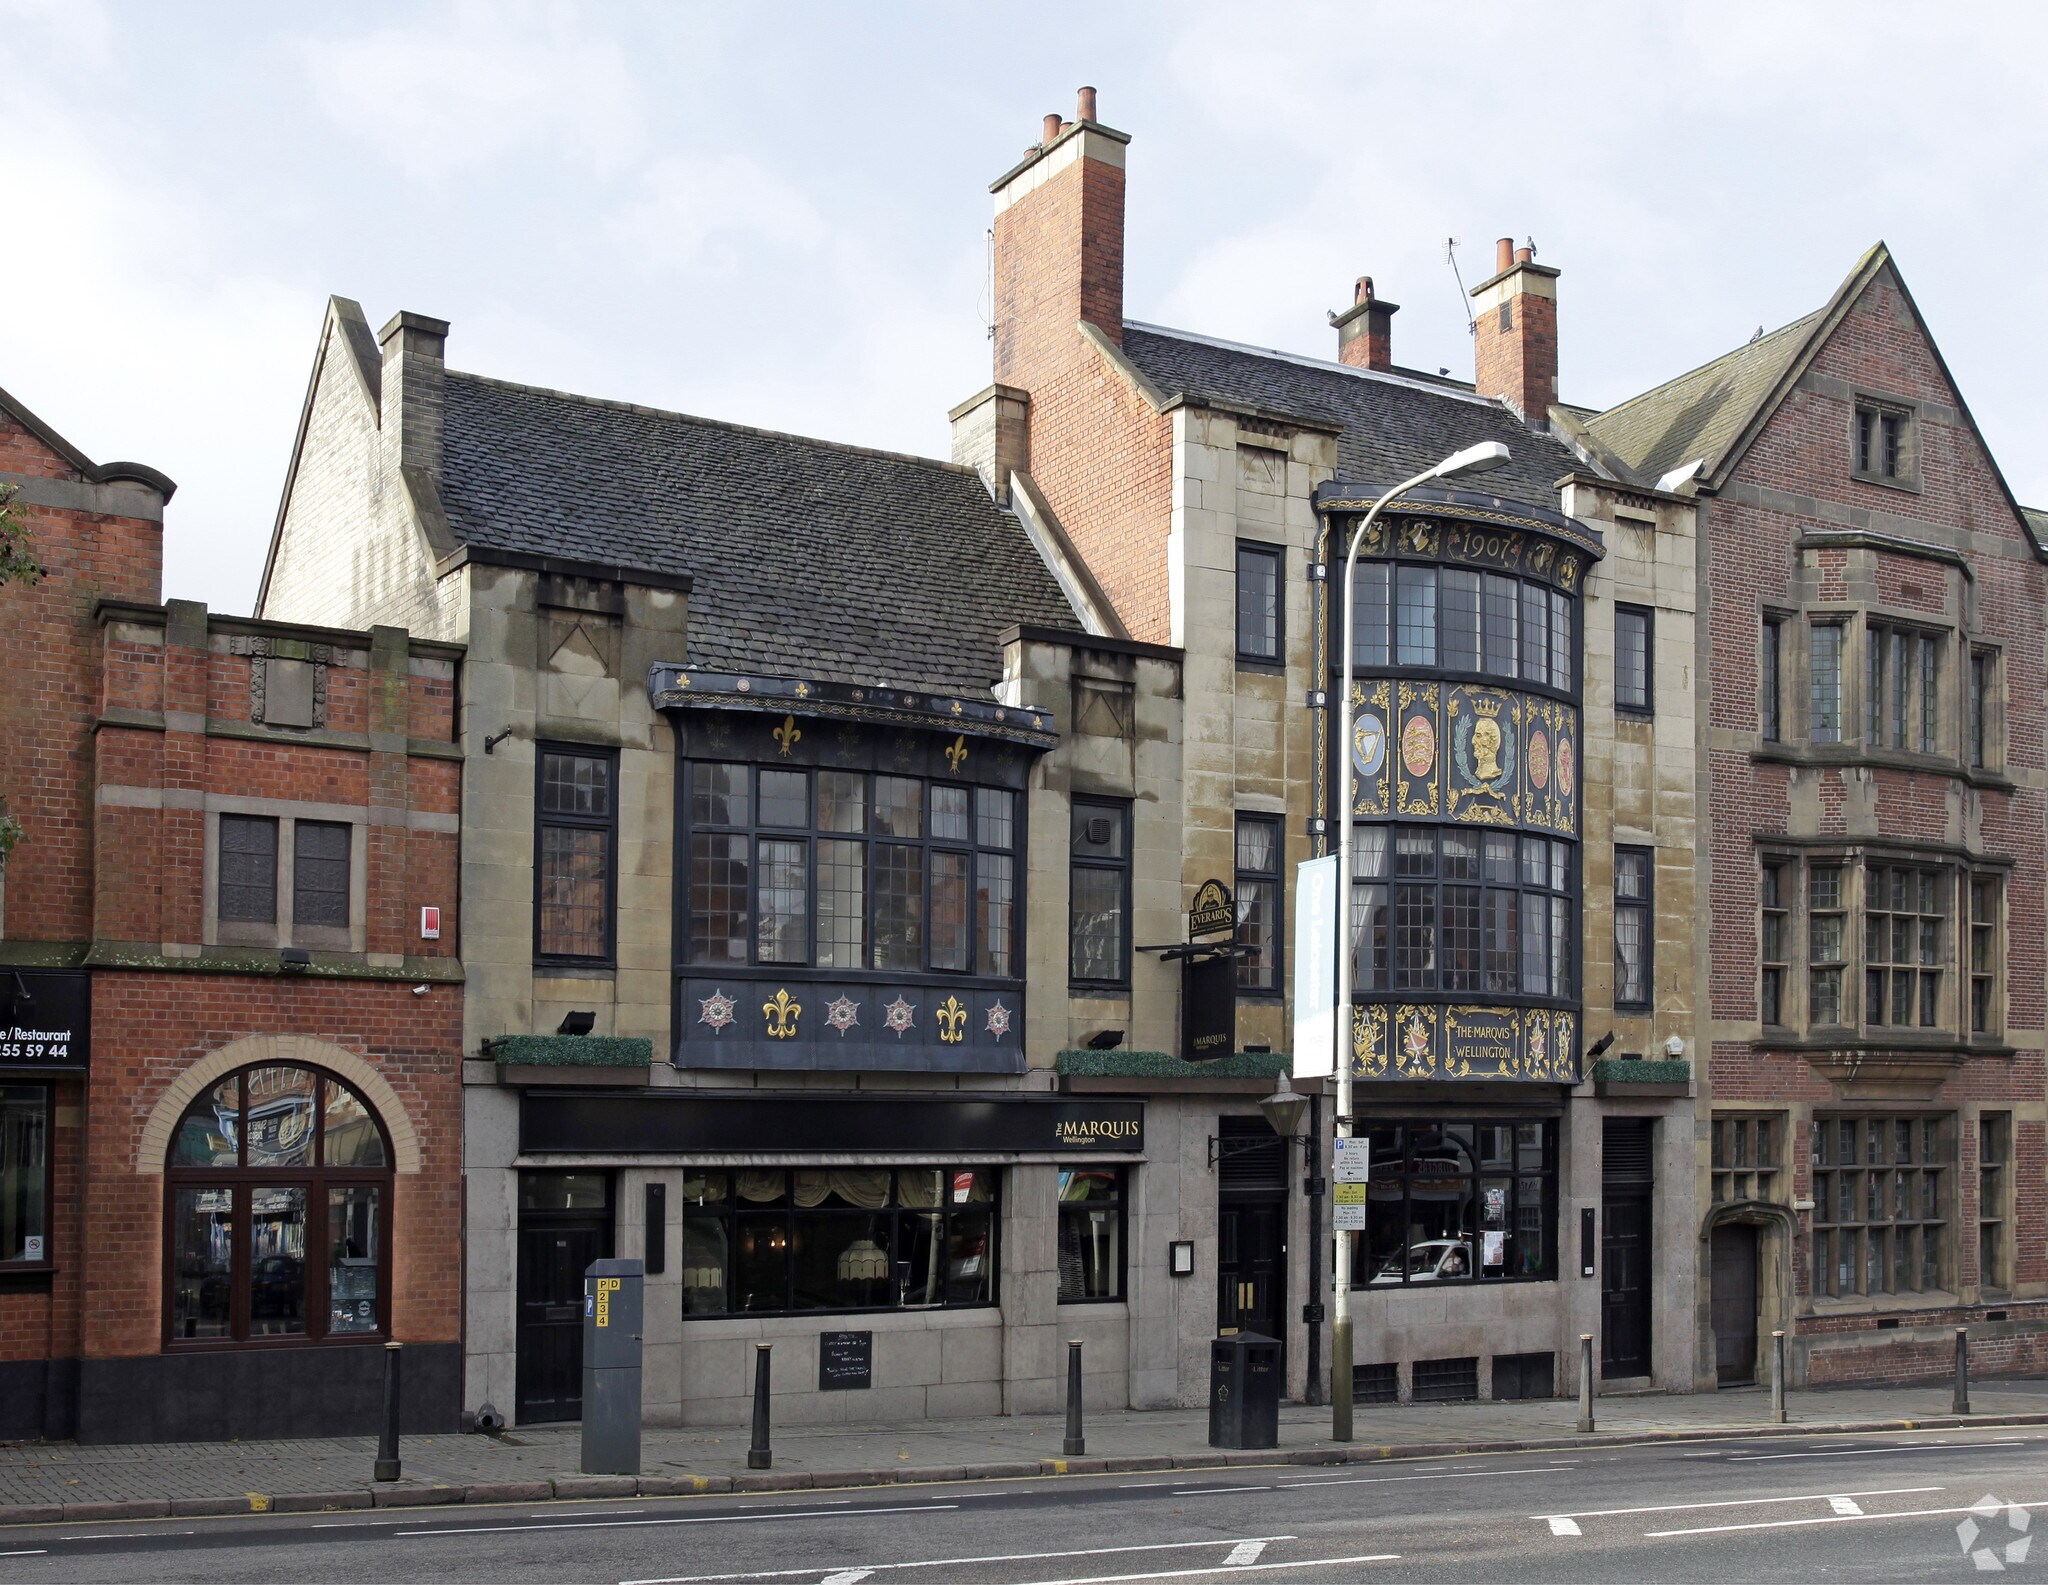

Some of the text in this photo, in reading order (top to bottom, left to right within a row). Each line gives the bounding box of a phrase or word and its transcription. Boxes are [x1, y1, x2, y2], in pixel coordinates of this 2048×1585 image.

[1463, 532, 1511, 560] 1907
[1190, 907, 1232, 930] EVERARDS
[14, 1027, 71, 1041] Restaurant
[1196, 1033, 1227, 1046] MARQUIS
[25, 1044, 44, 1057] 59
[48, 1045, 68, 1058] 44
[1455, 1046, 1511, 1058] WELLINGTON
[1063, 1121, 1139, 1139] MARQUIS
[1063, 1136, 1095, 1144] Wellington
[1338, 1140, 1343, 1148] P
[587, 1299, 593, 1313] P
